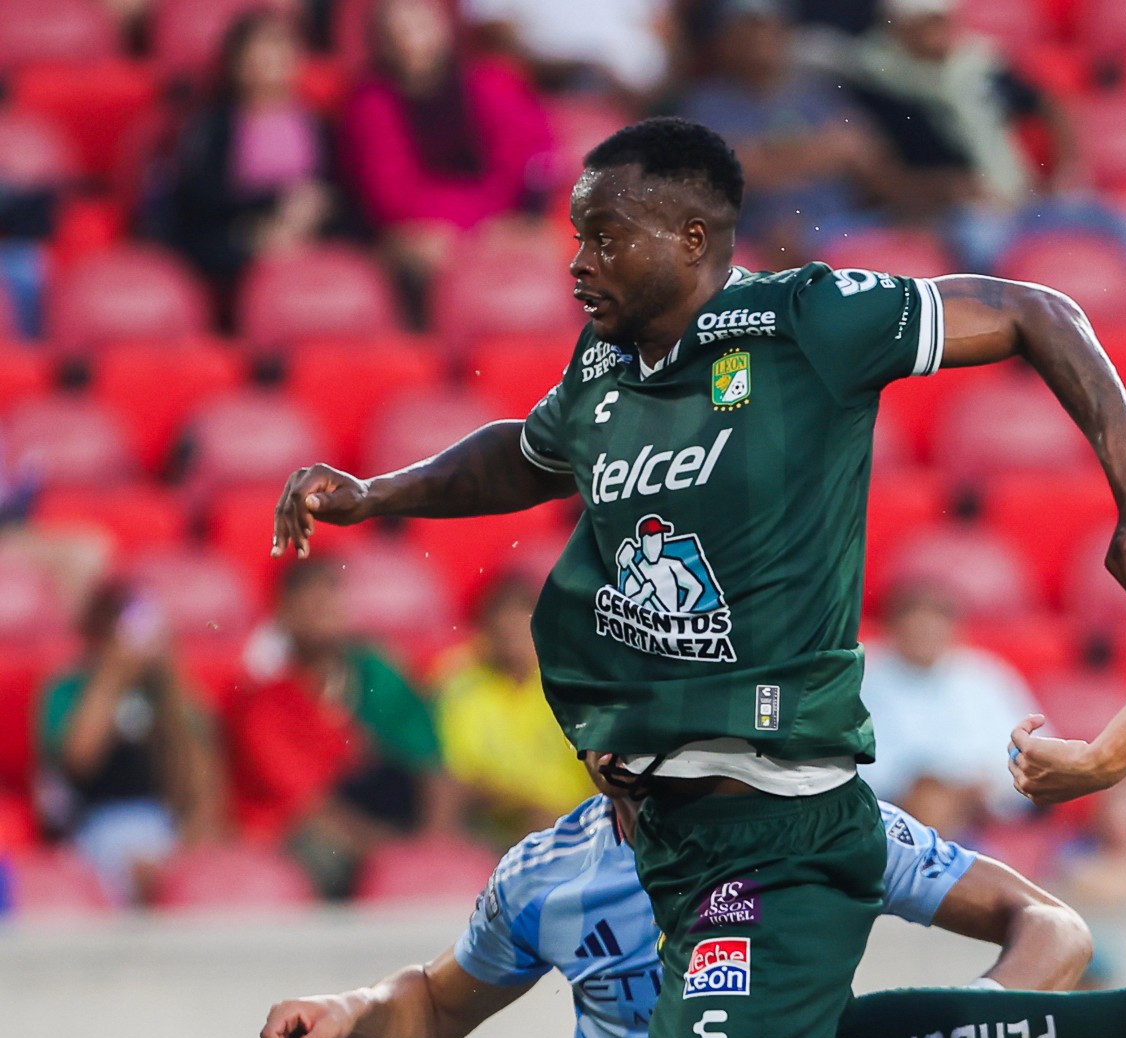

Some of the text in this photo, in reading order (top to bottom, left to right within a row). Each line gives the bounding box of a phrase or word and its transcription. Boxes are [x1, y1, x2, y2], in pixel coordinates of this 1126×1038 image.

[697, 309, 776, 330] Office
[592, 428, 733, 504] telcel
[597, 589, 730, 635] CEMENTOS
[597, 612, 737, 661] FORTALEZA
